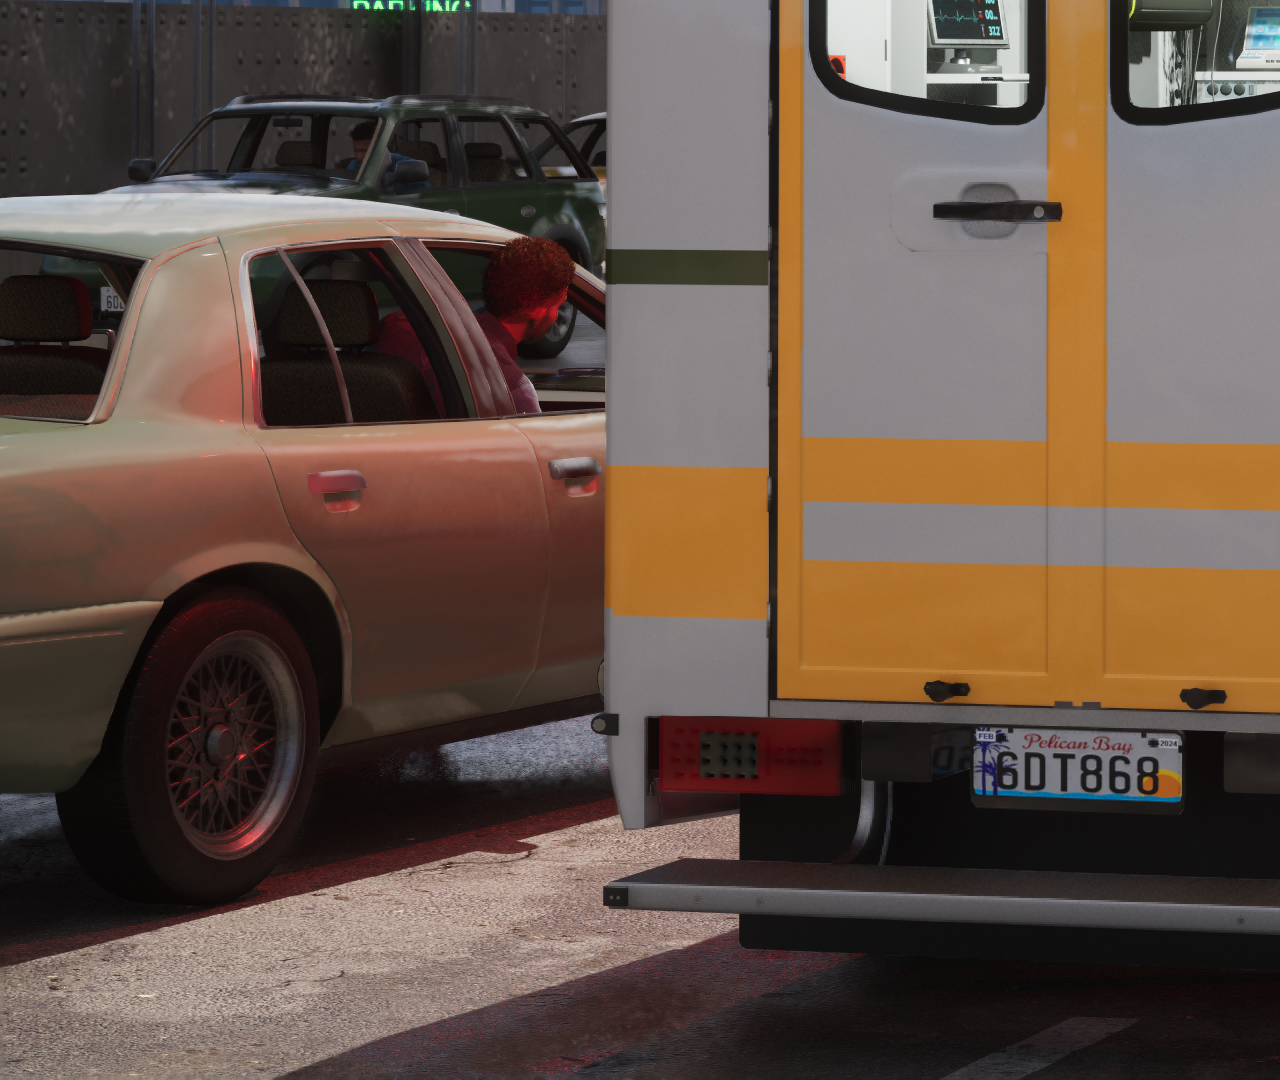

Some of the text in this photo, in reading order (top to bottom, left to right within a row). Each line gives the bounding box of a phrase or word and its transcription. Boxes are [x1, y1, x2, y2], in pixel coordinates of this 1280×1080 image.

[978, 732, 1178, 755] FEB Pelican Bay 2024
[996, 751, 1160, 795] 6DT868
